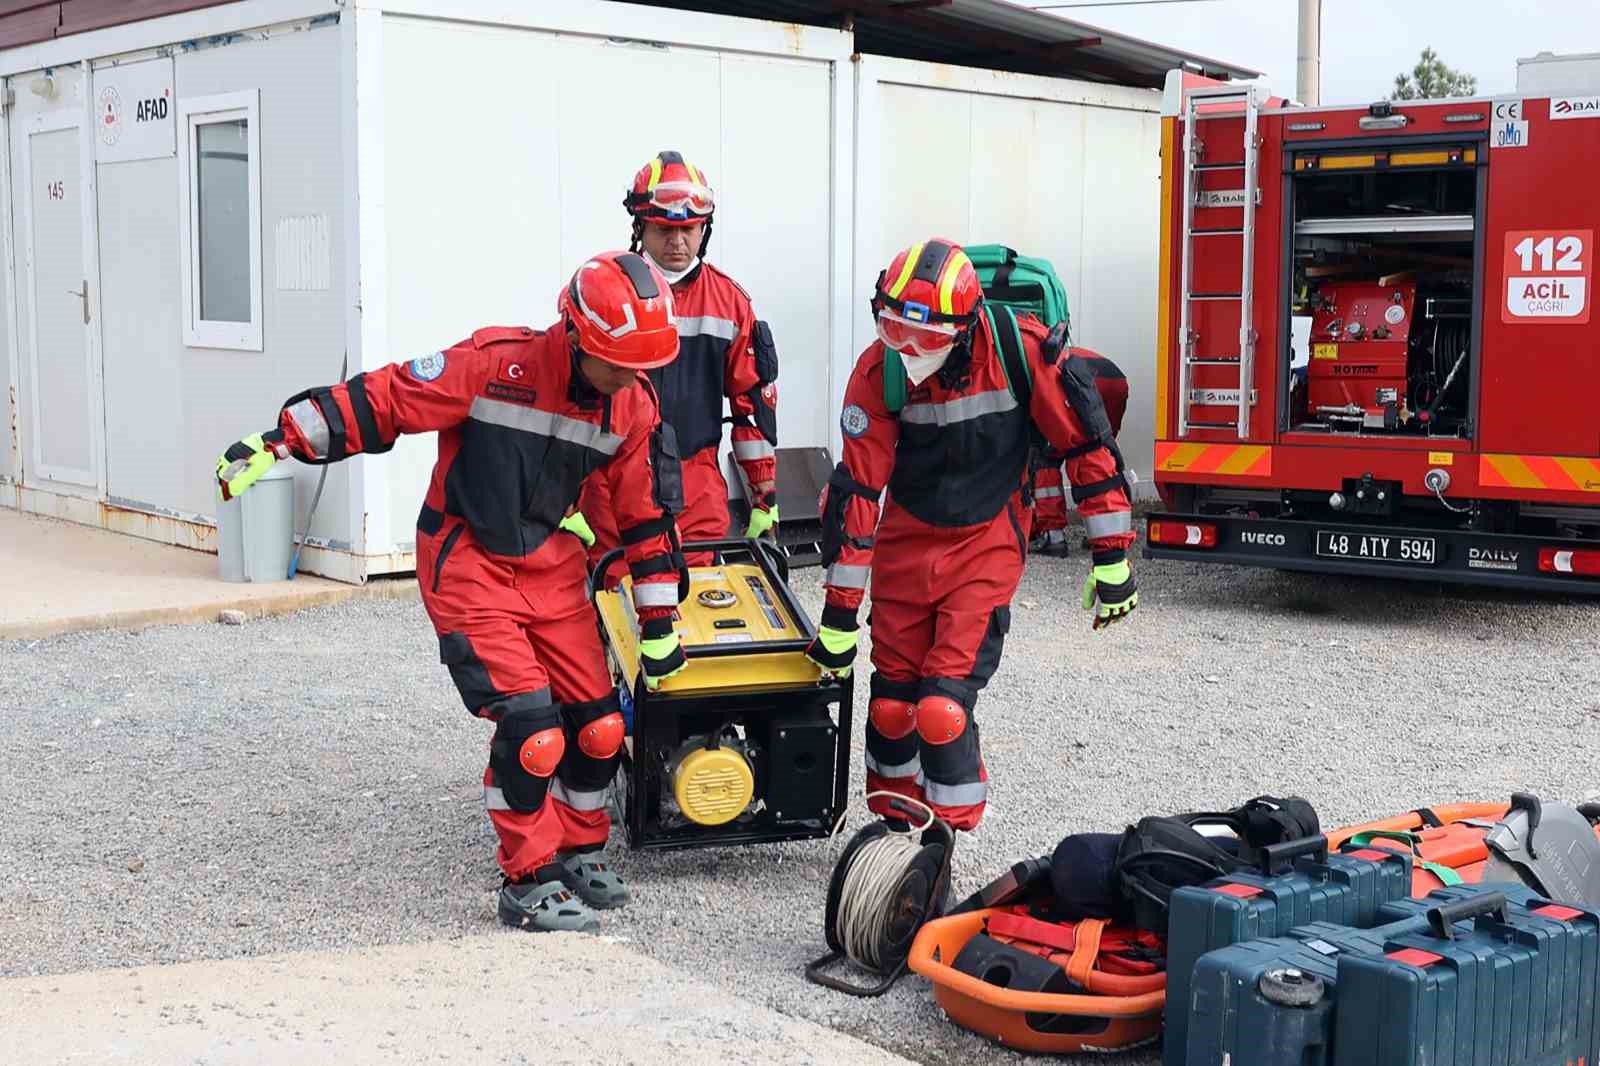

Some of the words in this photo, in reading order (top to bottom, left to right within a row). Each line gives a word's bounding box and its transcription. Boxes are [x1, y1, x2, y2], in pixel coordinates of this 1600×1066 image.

[136, 97, 168, 122] AFAD
[1496, 103, 1517, 119] CE
[47, 181, 64, 200] 145
[1514, 236, 1583, 271] 112
[1522, 279, 1570, 299] ACİL
[1527, 300, 1563, 314] ÇAĞRI
[1241, 531, 1286, 546] IVECO
[1329, 534, 1349, 554] 48
[1359, 537, 1389, 557] ATY
[1400, 540, 1432, 561] 594
[1469, 548, 1519, 561] DAILY
